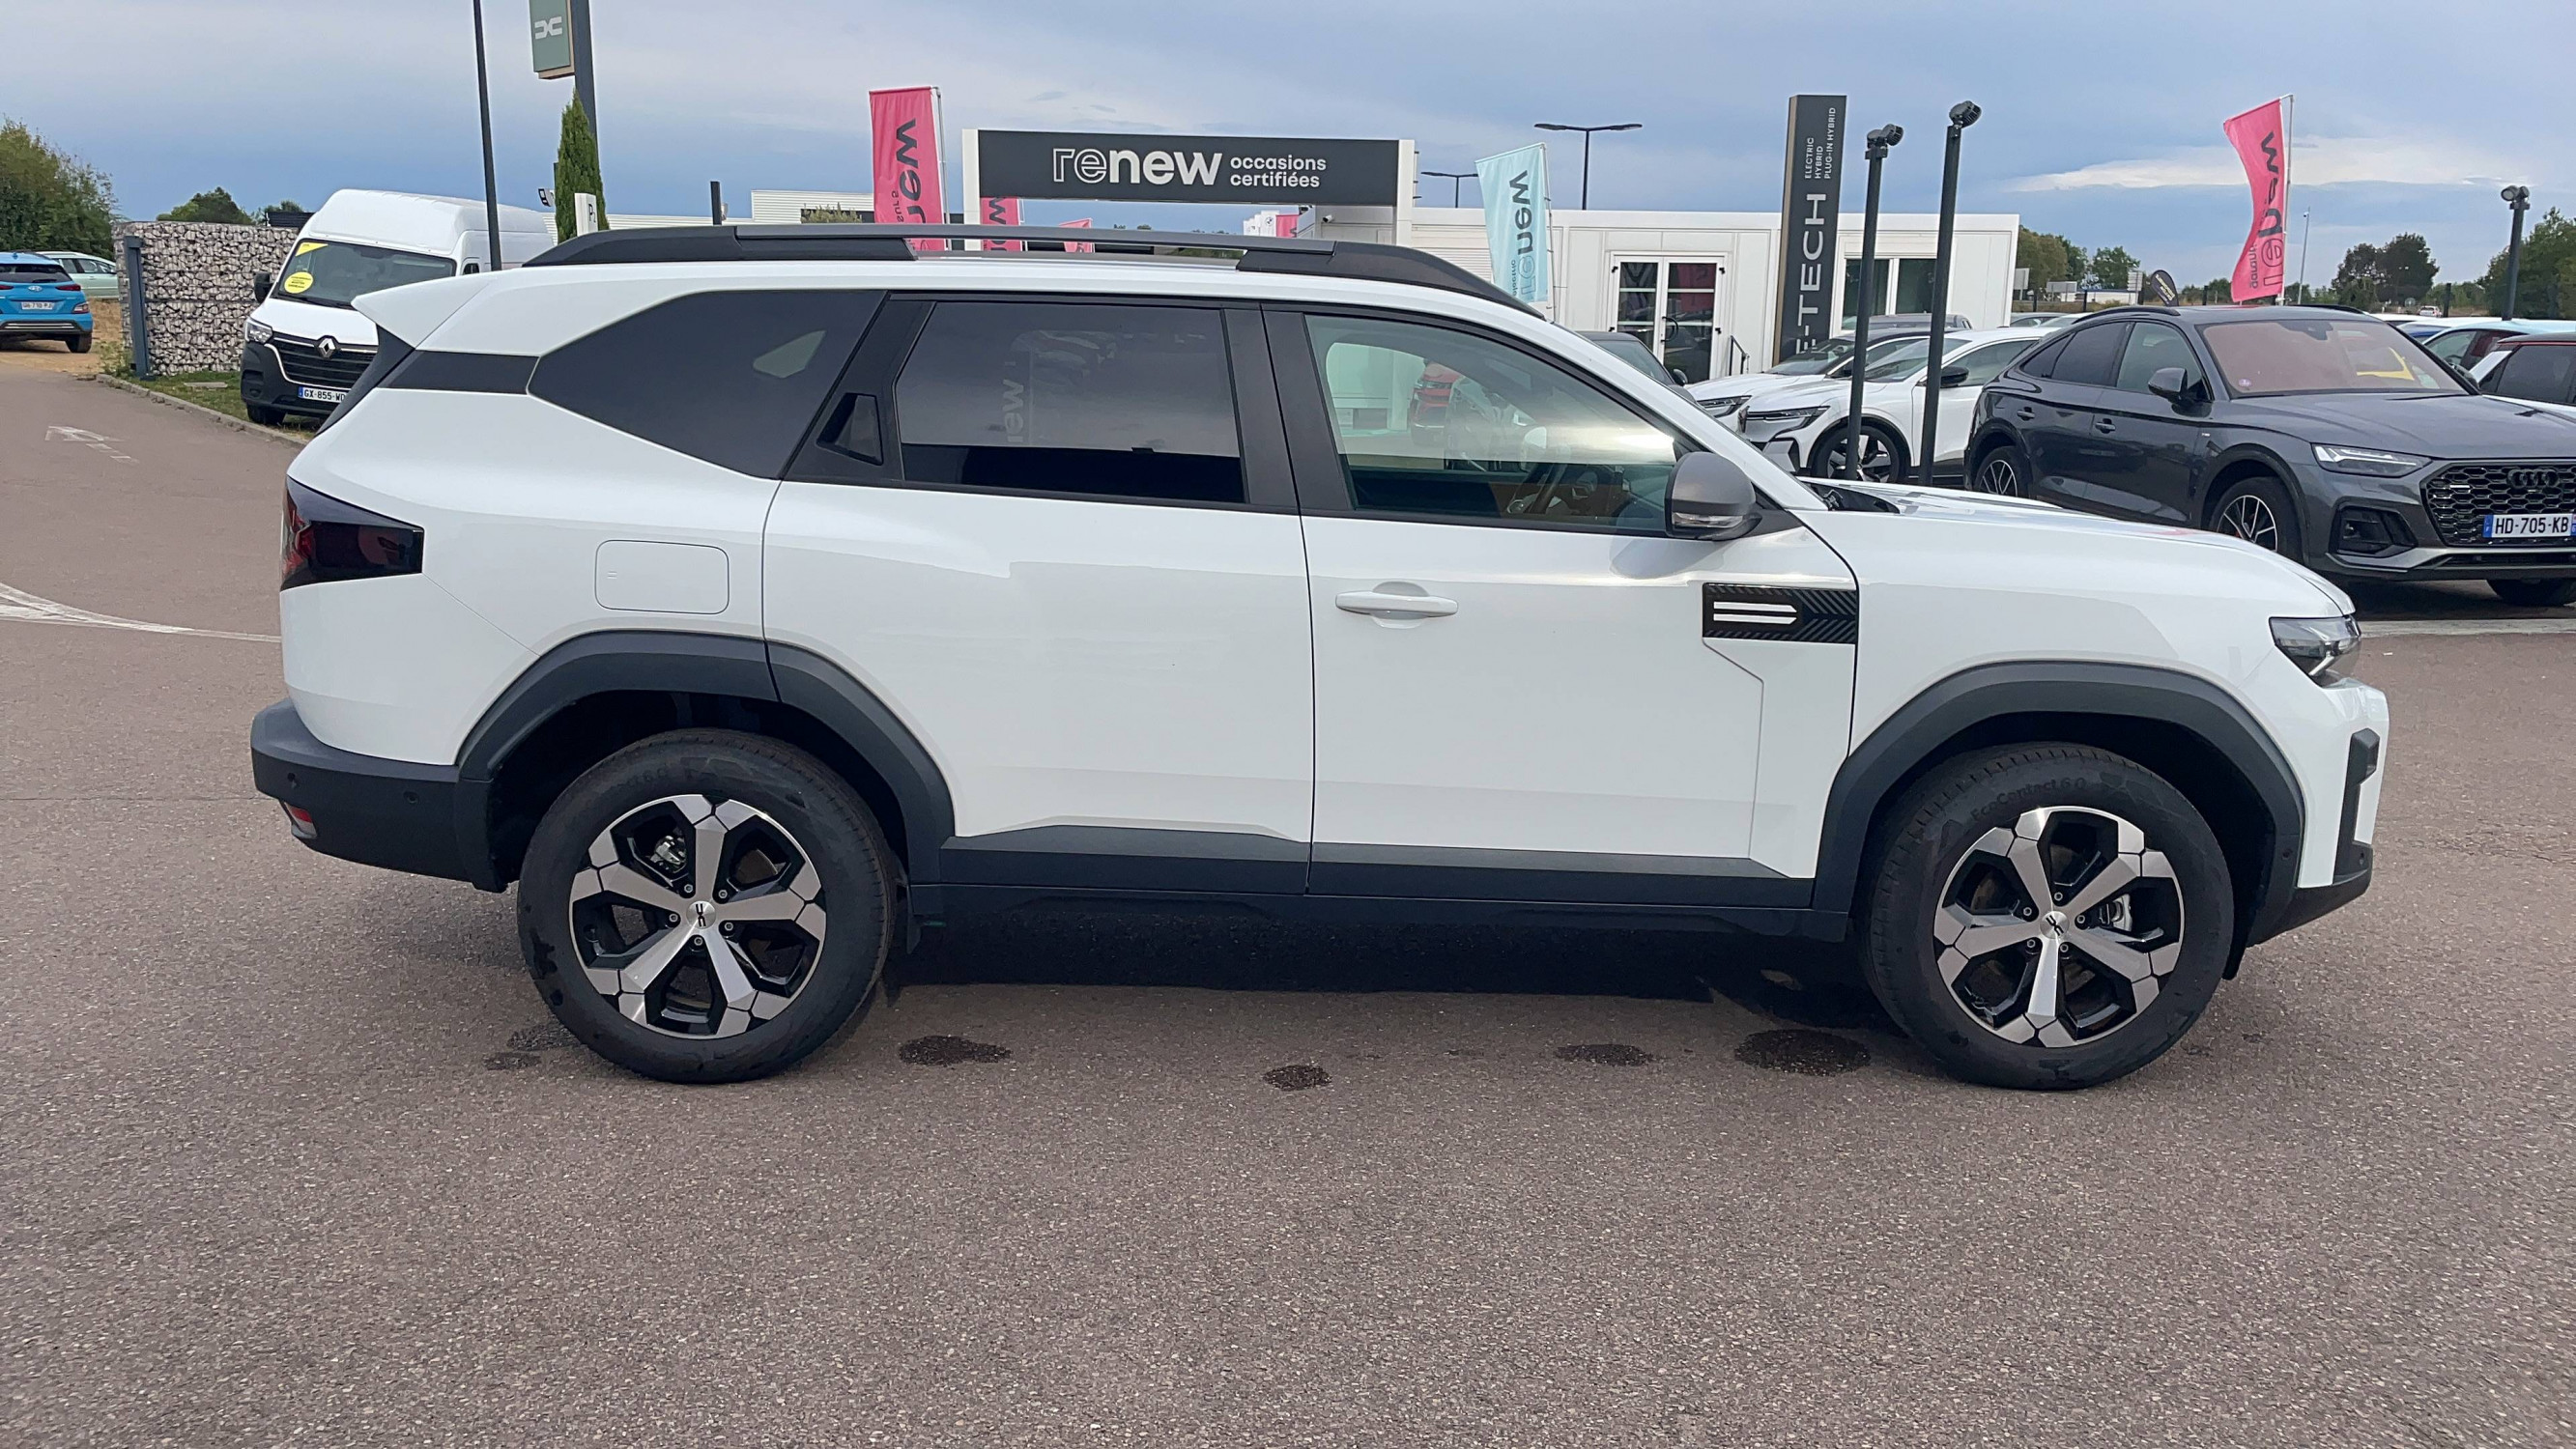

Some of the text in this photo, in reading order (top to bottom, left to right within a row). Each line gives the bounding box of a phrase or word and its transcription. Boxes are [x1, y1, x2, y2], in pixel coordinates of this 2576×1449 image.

[1805, 137, 1815, 179] ELECTRIC
[1824, 107, 1836, 179] PLUG-IN HYBRID
[1052, 148, 1222, 185] renew
[1230, 155, 1327, 171] occasions
[1815, 146, 1823, 179] HYBRID
[1230, 172, 1320, 187] certifiées
[2495, 517, 2569, 534] HD-705-KB
